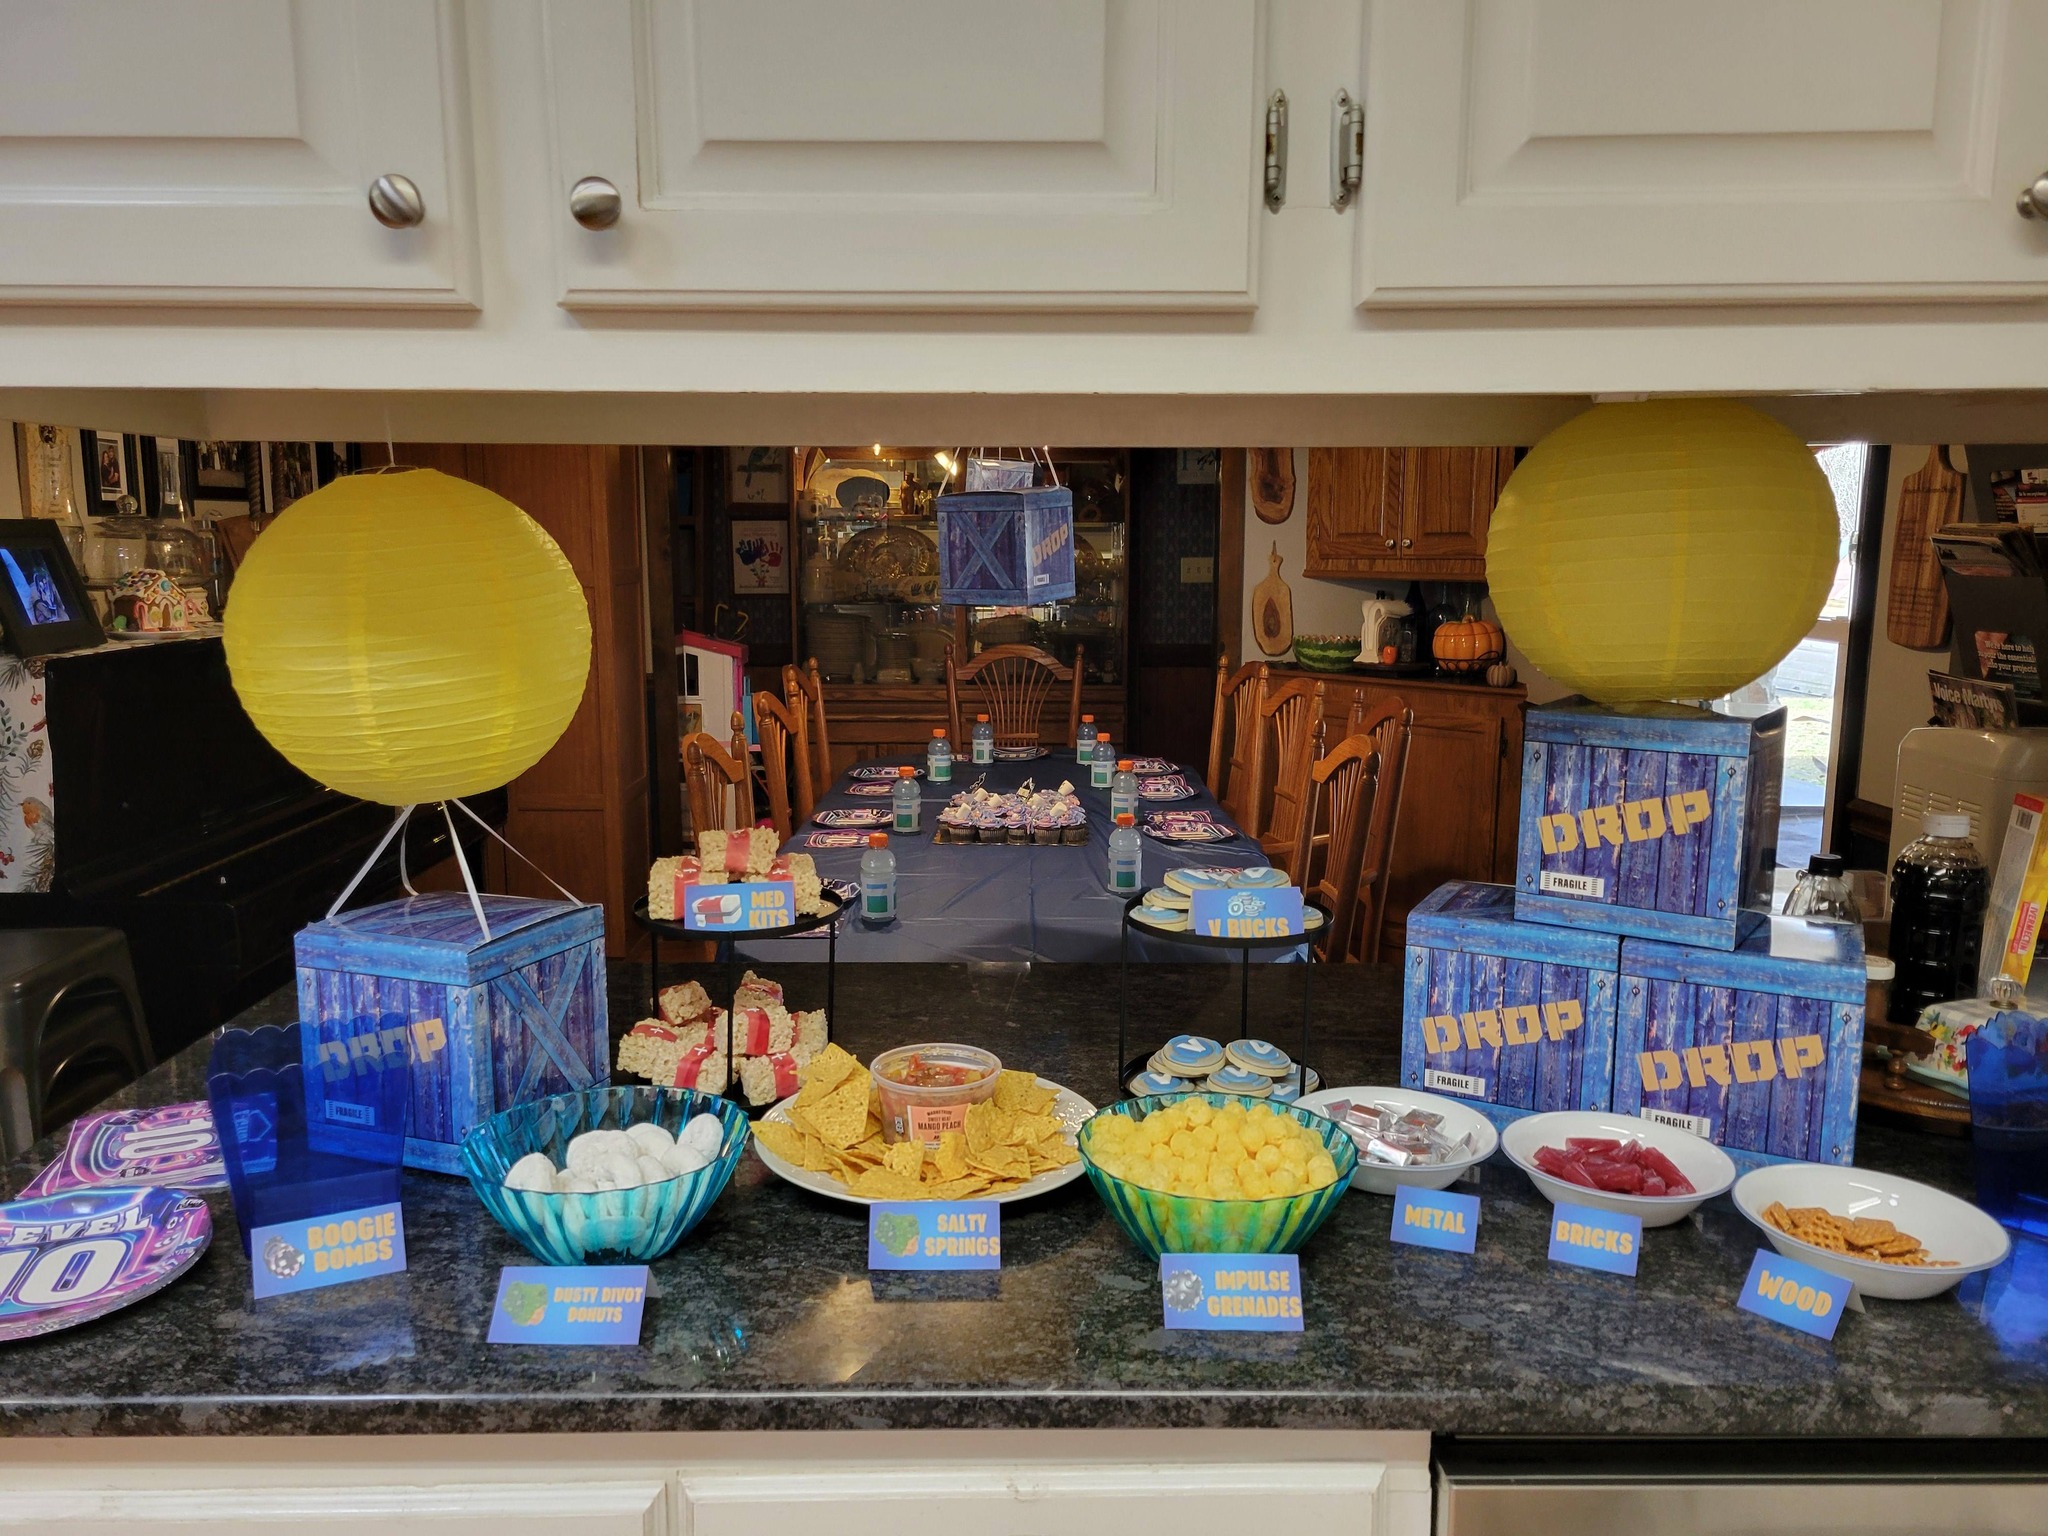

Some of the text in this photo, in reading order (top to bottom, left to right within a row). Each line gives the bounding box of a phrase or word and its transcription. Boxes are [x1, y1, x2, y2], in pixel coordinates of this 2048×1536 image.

[1033, 523, 1069, 568] DROP
[1933, 682, 1961, 704] Voice
[1536, 789, 1711, 855] DROP
[1553, 877, 1587, 891] FRAGILE
[751, 890, 785, 908] MED
[749, 909, 790, 928] KITS
[1208, 917, 1290, 938] V BUCKS
[1421, 999, 1584, 1054] DROP
[319, 1018, 447, 1083] DROP
[1635, 1034, 1825, 1092] DROP
[1437, 1075, 1470, 1089] FRAGILE
[335, 1106, 363, 1120] FRAGILE
[1655, 1114, 1692, 1130] FRAGILE
[918, 1120, 962, 1131] MANGO PEACH
[6, 1206, 150, 1246] EVEL
[937, 1213, 987, 1233] SALTY
[1404, 1204, 1466, 1234] METAL
[307, 1212, 396, 1250] BOOGIE
[1556, 1220, 1633, 1255] BRICKS
[314, 1238, 393, 1273] BOMBS
[925, 1236, 1000, 1257] SPRINGS
[1215, 1270, 1291, 1292] IMPULSE
[554, 1286, 643, 1303] DUSTY DIVOT
[1757, 1269, 1832, 1317] WOOD
[567, 1306, 622, 1323] DONUTS
[1207, 1295, 1302, 1318] GRENADES
